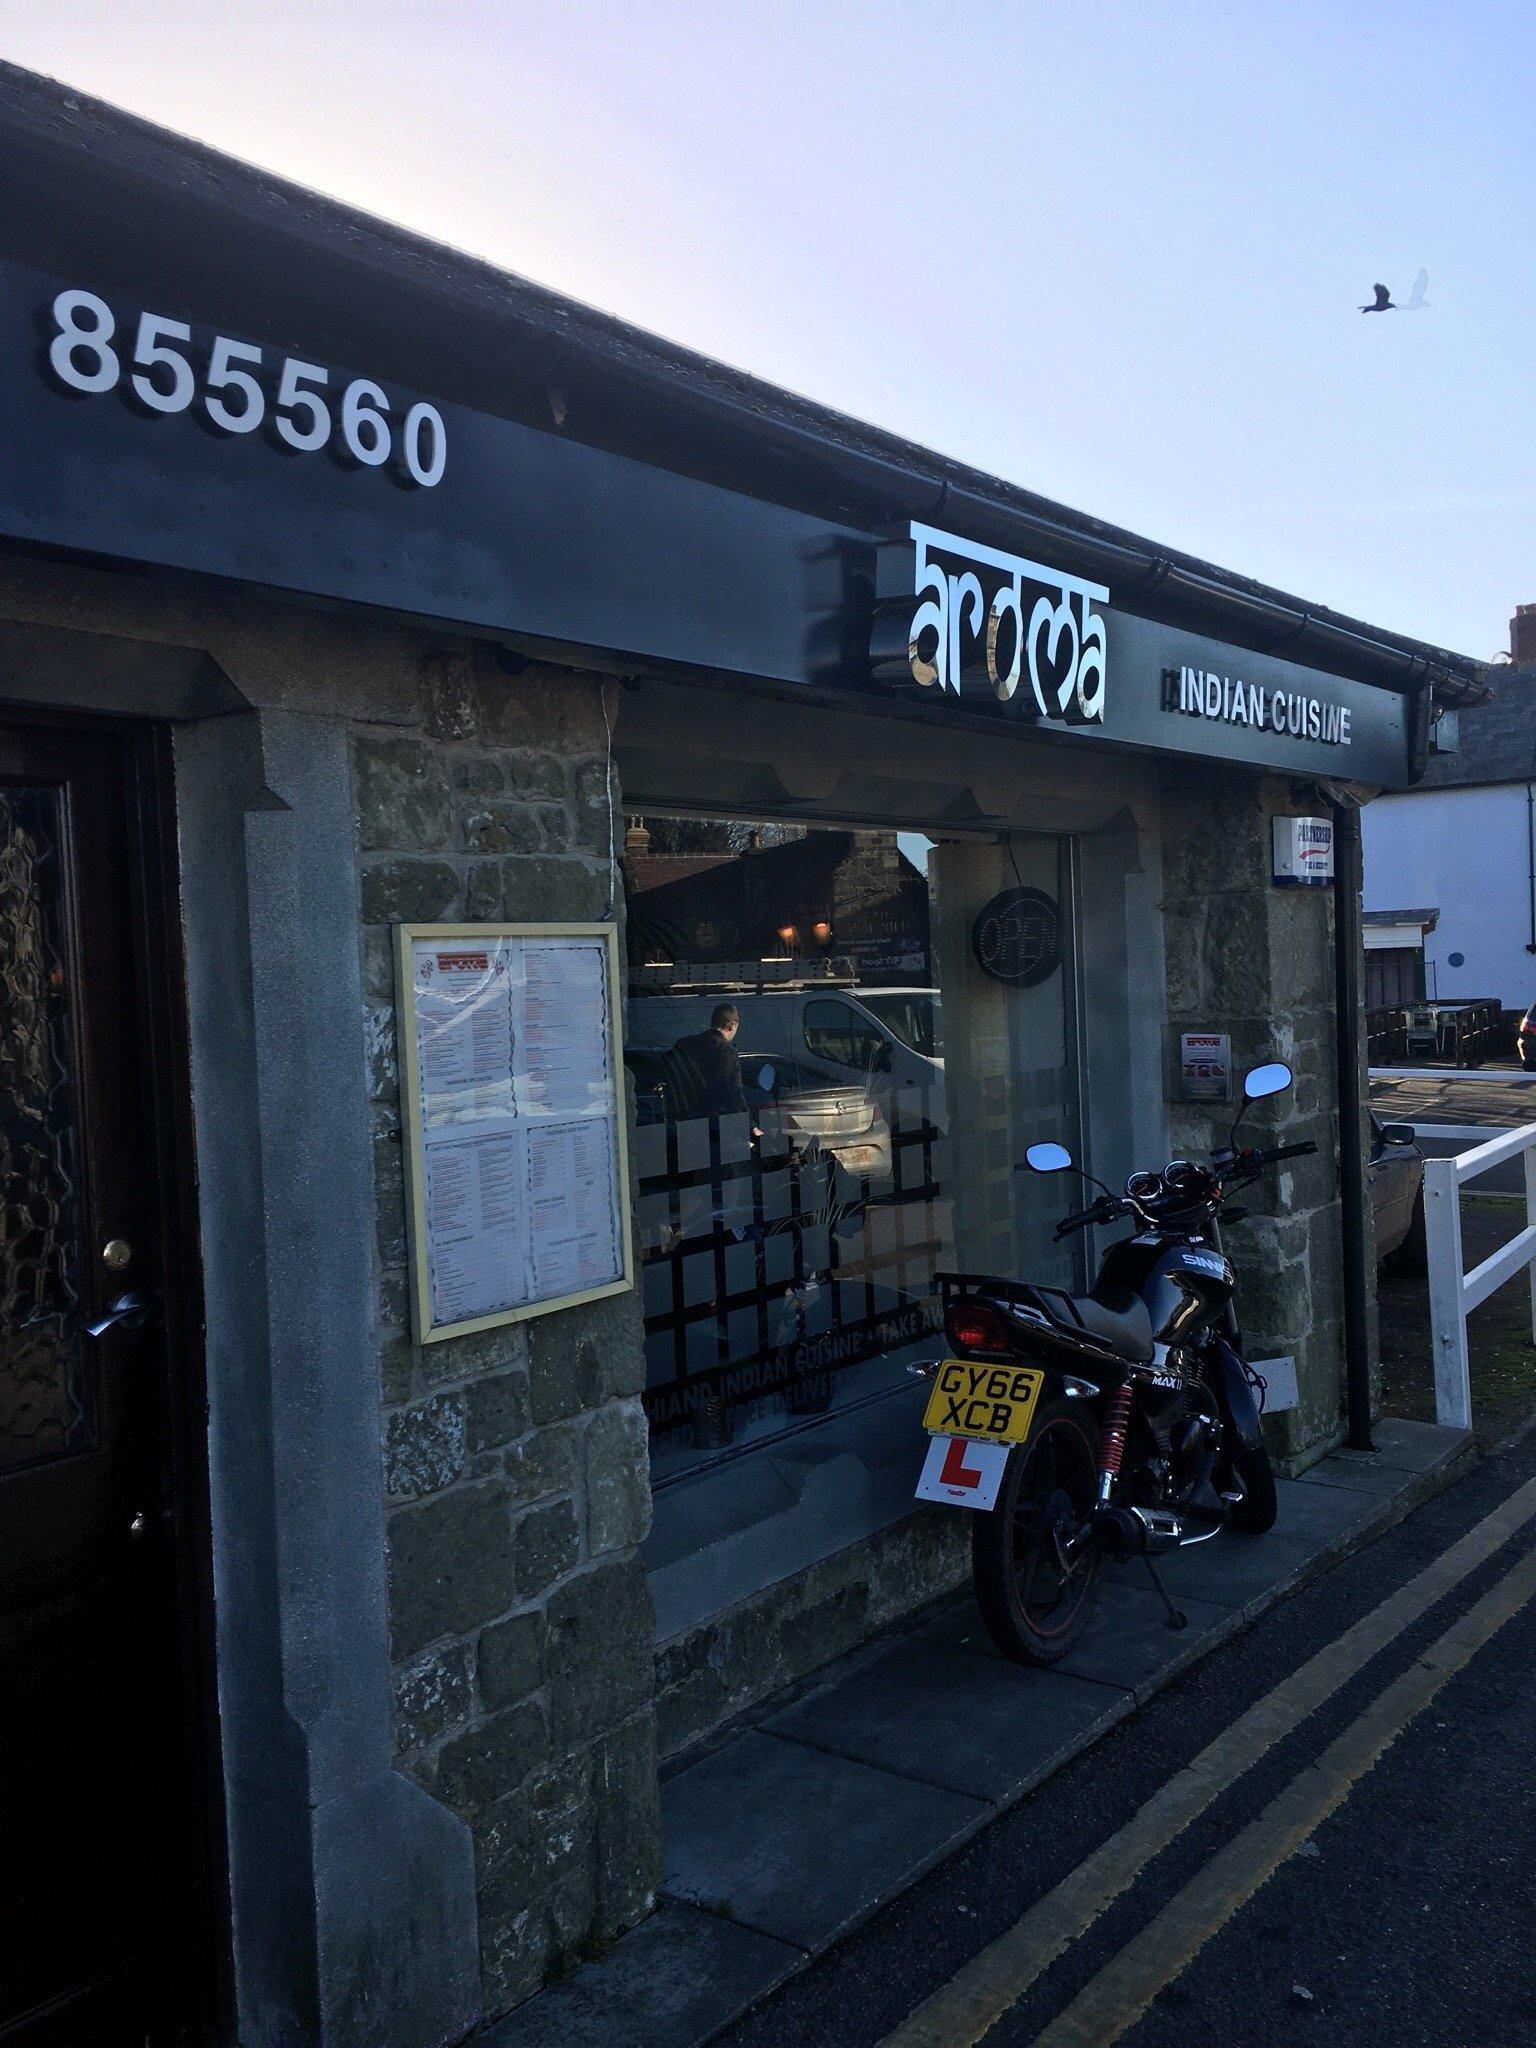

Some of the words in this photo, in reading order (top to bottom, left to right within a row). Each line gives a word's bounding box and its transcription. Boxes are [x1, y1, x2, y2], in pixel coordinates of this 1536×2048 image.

[50, 290, 446, 487] 855560
[1180, 666, 1264, 727] INDIAN
[1271, 690, 1351, 745] CUISINE
[980, 917, 1057, 961] OPEN
[718, 1355, 788, 1400] INDIAN
[941, 1365, 1035, 1402] GY66
[1152, 1376, 1176, 1389] MAX
[941, 1396, 1012, 1434] XCB
[939, 1438, 982, 1489] L
